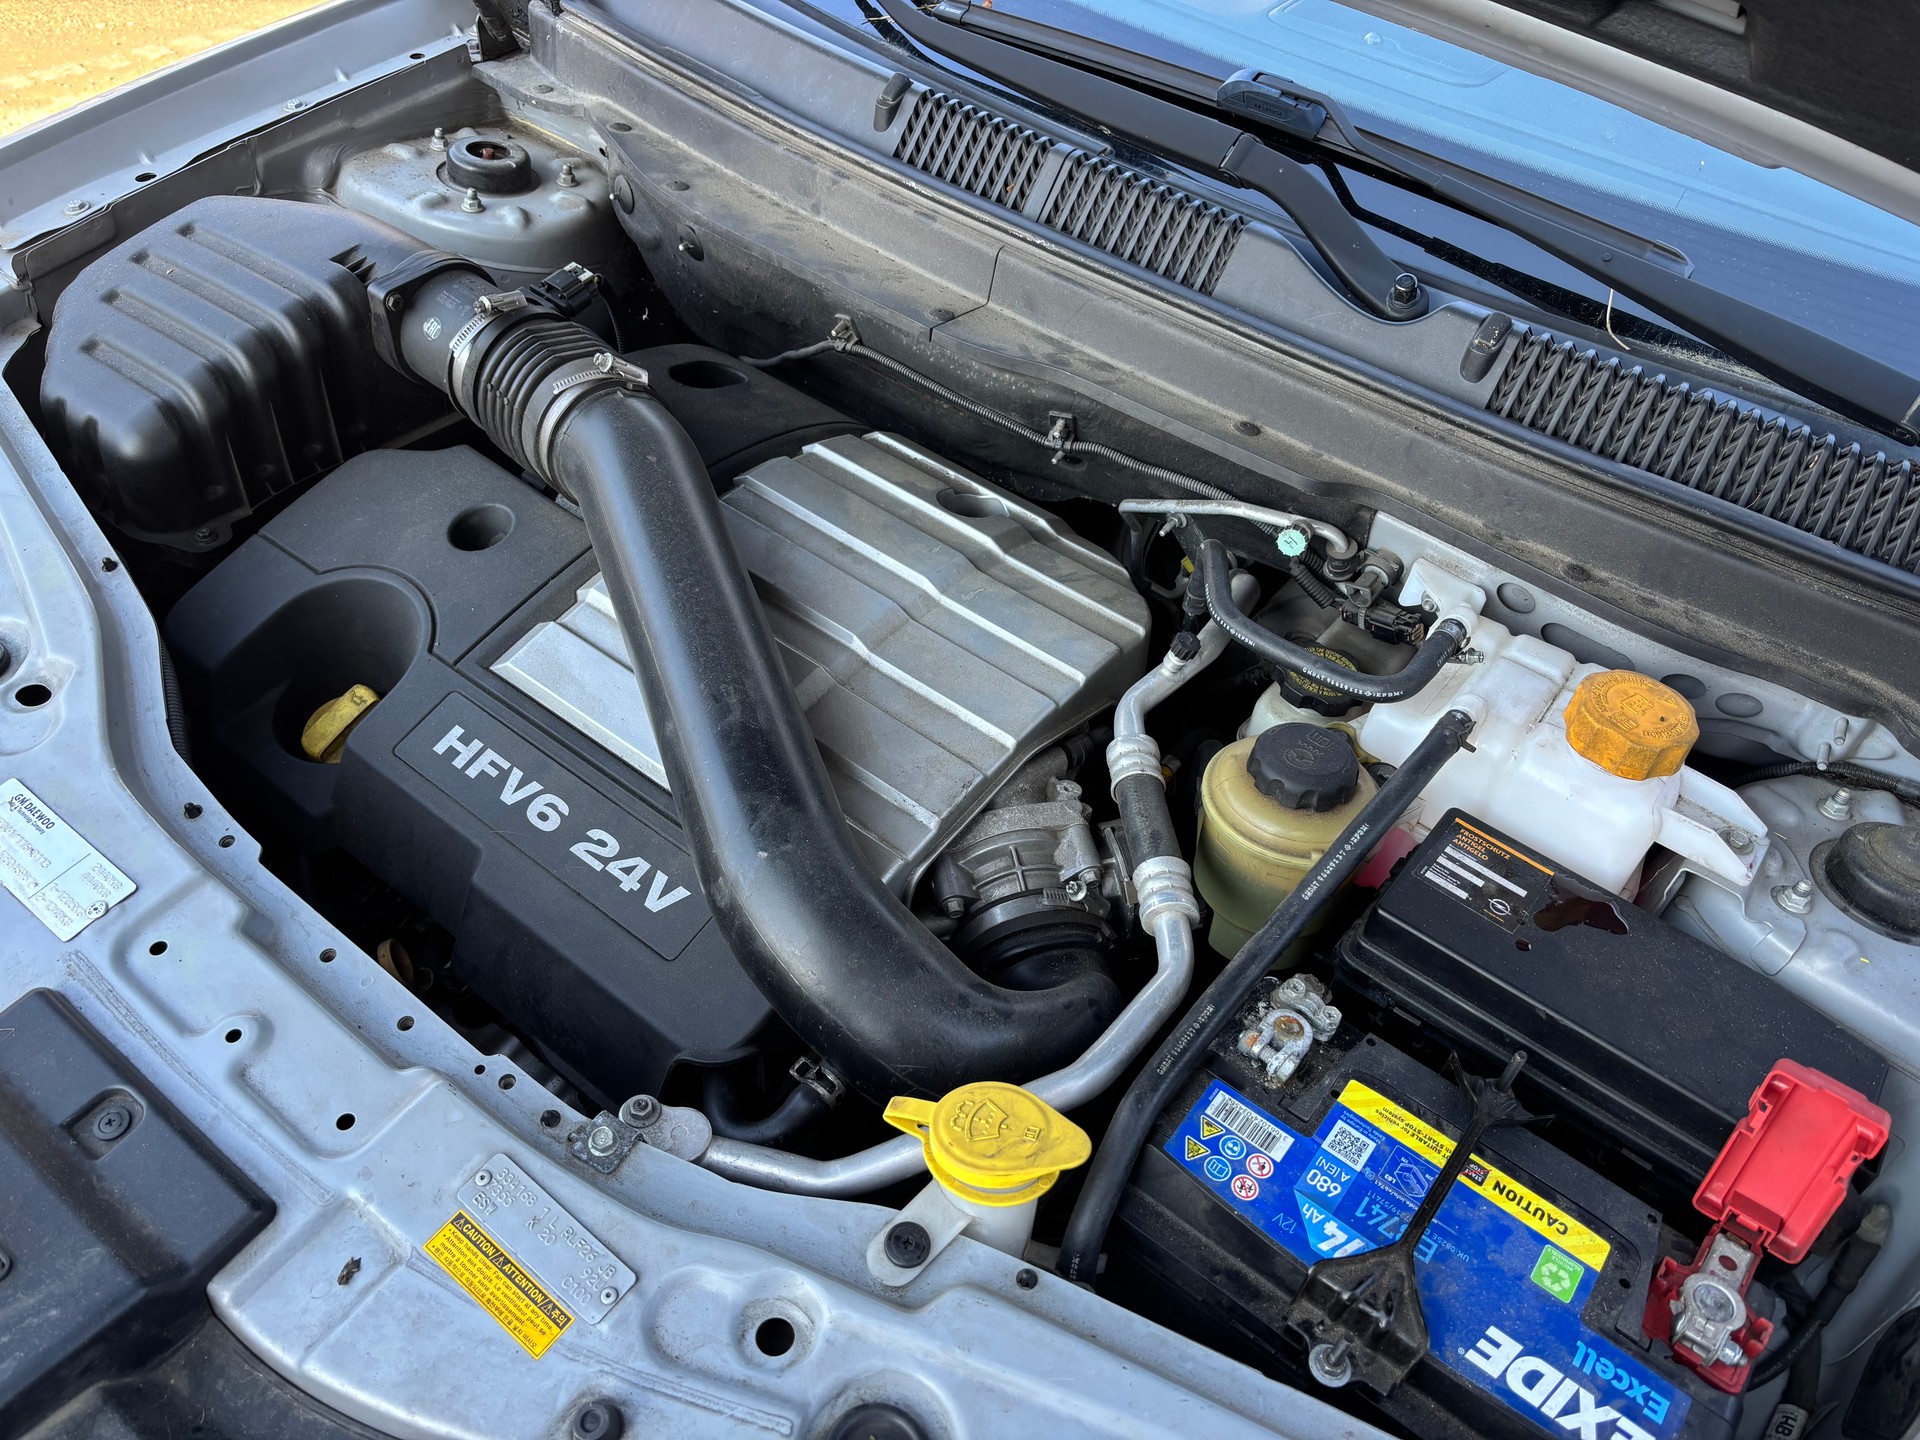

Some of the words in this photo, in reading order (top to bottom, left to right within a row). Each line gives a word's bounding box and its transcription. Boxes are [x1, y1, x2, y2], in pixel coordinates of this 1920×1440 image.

[430, 720, 573, 838] HFV6
[12, 791, 28, 807] GM
[23, 800, 56, 831] DAEWOO
[1451, 836, 1489, 861] ANTIGELO
[1455, 832, 1487, 853] ANTIGEL
[1458, 827, 1511, 861] FROSTSCHUTZ
[568, 819, 691, 923] 24V
[1252, 1114, 1280, 1136] 661024
[1342, 1109, 1373, 1132] Technologies
[1345, 1117, 1364, 1131] Europe
[1373, 1107, 1400, 1127] vehicles
[1381, 1105, 1405, 1123] system
[1366, 1131, 1382, 1143] Made
[1371, 1129, 1386, 1140] Exide
[1398, 1124, 1410, 1134] for
[1403, 1120, 1445, 1149] START-STOP
[1409, 1131, 1443, 1155] SUITABLE
[1313, 1154, 1342, 1178] (EN)
[1337, 1169, 1351, 1184] A
[1303, 1166, 1344, 1201] 680
[470, 1190, 498, 1217] ESW
[1298, 1201, 1326, 1226] Ah
[1490, 1177, 1571, 1237] CAUTION
[495, 1166, 538, 1208] 334168
[558, 1225, 598, 1264] RLF26
[595, 1259, 616, 1281] JB
[1270, 1208, 1300, 1235] 12V
[535, 1226, 557, 1247] 20
[1430, 1231, 1470, 1262] UK:082SE
[438, 1240, 457, 1258] mettre
[458, 1260, 478, 1280] tourner
[476, 1278, 490, 1292] sans
[449, 1229, 465, 1246] Keep
[462, 1241, 480, 1259] hands
[491, 1269, 504, 1282] Fan
[501, 1279, 513, 1291] can
[511, 1289, 526, 1304] start
[528, 1307, 541, 1320] any
[444, 1235, 469, 1259] Attention
[466, 1256, 478, 1268] aux
[499, 1289, 528, 1318] ventilateur
[525, 1314, 540, 1330] peut
[558, 1274, 593, 1307] C100
[548, 1307, 568, 1327] 주의
[1566, 1338, 1673, 1425] Excell
